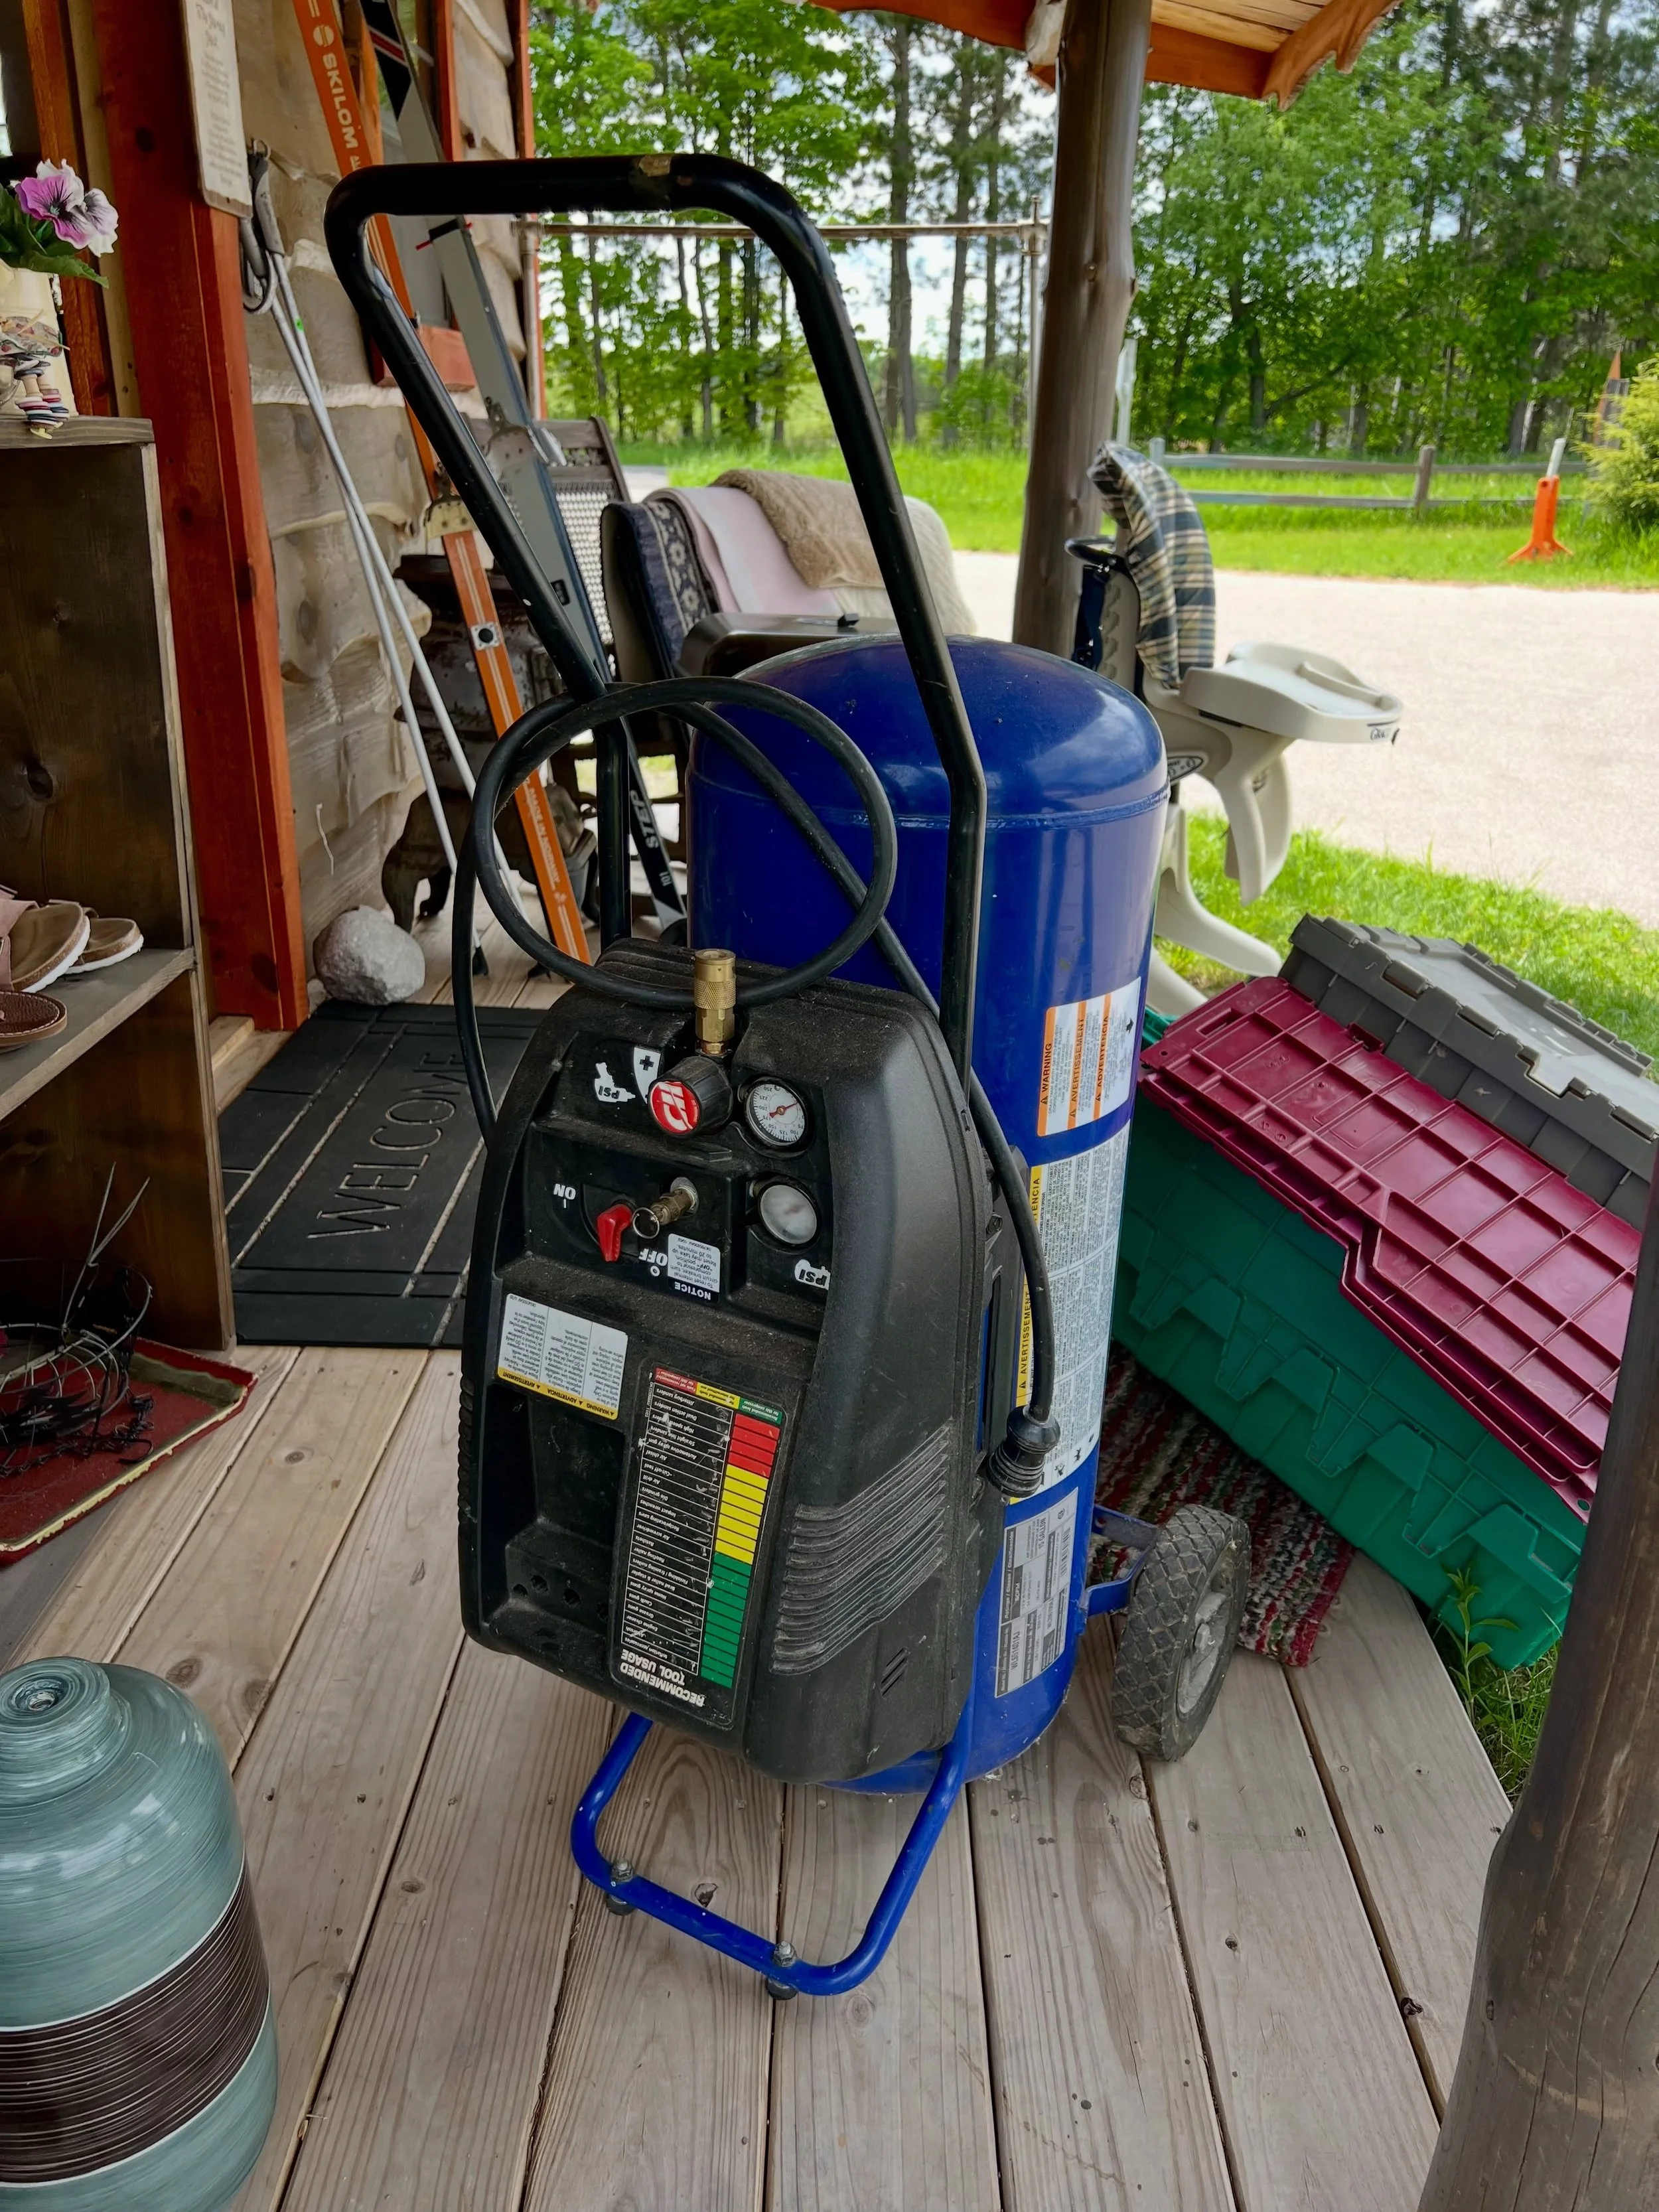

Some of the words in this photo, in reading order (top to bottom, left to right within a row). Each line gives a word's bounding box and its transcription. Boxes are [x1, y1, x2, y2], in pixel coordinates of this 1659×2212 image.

[323, 52, 359, 149] SKILOM
[630, 789, 660, 849] STEP
[1097, 1015, 1108, 1088] ADVERTENCIA
[1070, 1016, 1084, 1103] AVERTISSEMENT
[1041, 1042, 1052, 1092] WARNING
[597, 1084, 620, 1100] PSI
[307, 1052, 469, 1239] WELCOME
[552, 1182, 577, 1201] ON
[638, 1246, 668, 1267] OFF
[684, 1263, 710, 1276] compressor
[674, 1271, 693, 1282] internal
[703, 1275, 717, 1284] circuit
[798, 1268, 827, 1287] PSI
[674, 1281, 711, 1300] NOTICE
[1021, 1292, 1031, 1374] AVERTISSEMENT
[502, 1371, 535, 1387] AVERTISSEMENT
[547, 1388, 577, 1403] ADVERTENCIA
[656, 1387, 674, 1398] sanders
[674, 1392, 694, 1406] Jitterbug
[586, 1402, 610, 1415] WARNING
[654, 1400, 672, 1412] sanders
[672, 1407, 687, 1417] action
[686, 1412, 697, 1421] Dual
[669, 1419, 683, 1429] speed
[683, 1424, 694, 1434] High
[650, 1425, 668, 1436] sanders
[648, 1436, 658, 1445] gun
[658, 1439, 670, 1449] spray
[677, 1434, 695, 1446] Straight
[645, 1448, 659, 1458] chisel
[670, 1445, 697, 1460] Automotive
[642, 1473, 652, 1482] drill
[641, 1485, 660, 1497] grinders
[639, 1499, 660, 1512] wrenches
[638, 1511, 650, 1519] saws
[660, 1506, 676, 1518] Impact
[650, 1514, 680, 1532] Reciprocating
[636, 1522, 662, 1538] screwdriver
[634, 1534, 654, 1547] Ratchets
[1038, 1540, 1044, 1549] 15
[633, 1546, 647, 1556] nailer
[647, 1550, 665, 1563] Roofing
[632, 1557, 648, 1568] nailers
[630, 1567, 646, 1579] stapler
[648, 1563, 665, 1576] framing
[650, 1576, 663, 1586] nailer
[667, 1571, 688, 1585] Finishing
[630, 1580, 641, 1589] guns
[640, 1584, 654, 1595] spray
[663, 1582, 675, 1591] Brad
[628, 1591, 640, 1601] guns
[639, 1596, 652, 1607] Caulk
[654, 1590, 666, 1601] Home
[627, 1603, 638, 1612] guns
[638, 1607, 654, 1619] Grease
[626, 1613, 642, 1625] cleaner
[642, 1620, 658, 1632] Engine
[648, 1647, 667, 1659] Inflation
[620, 1647, 657, 1674] USAGE
[658, 1664, 686, 1686] TOOL
[619, 1660, 705, 1708] RECOMMENDED
